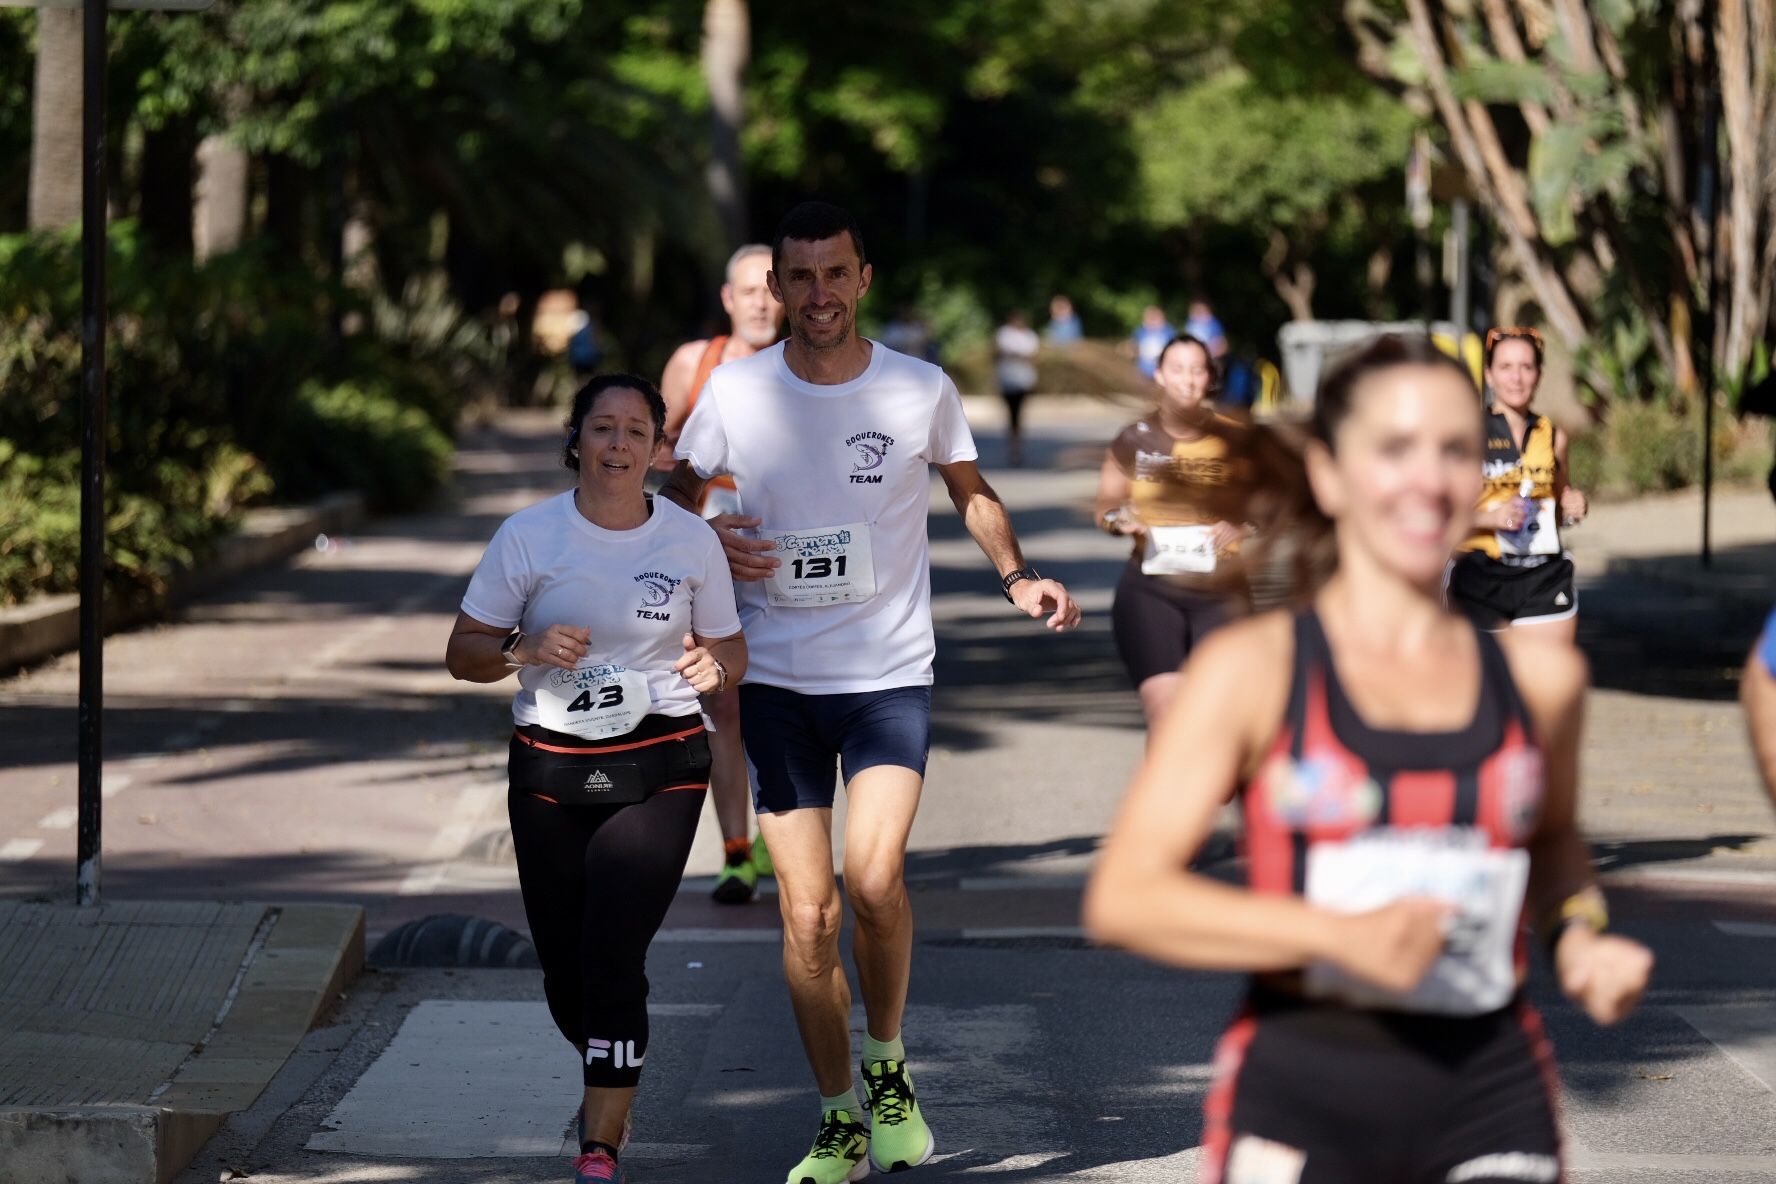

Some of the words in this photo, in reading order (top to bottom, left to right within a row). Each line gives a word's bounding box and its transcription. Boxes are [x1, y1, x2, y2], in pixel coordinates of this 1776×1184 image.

[845, 431, 895, 446] BOQUERONES
[849, 475, 883, 484] TEAM
[792, 556, 846, 579] 131
[633, 571, 682, 586] BOQUERONES
[636, 609, 671, 622] TEAM
[567, 685, 623, 712] 43
